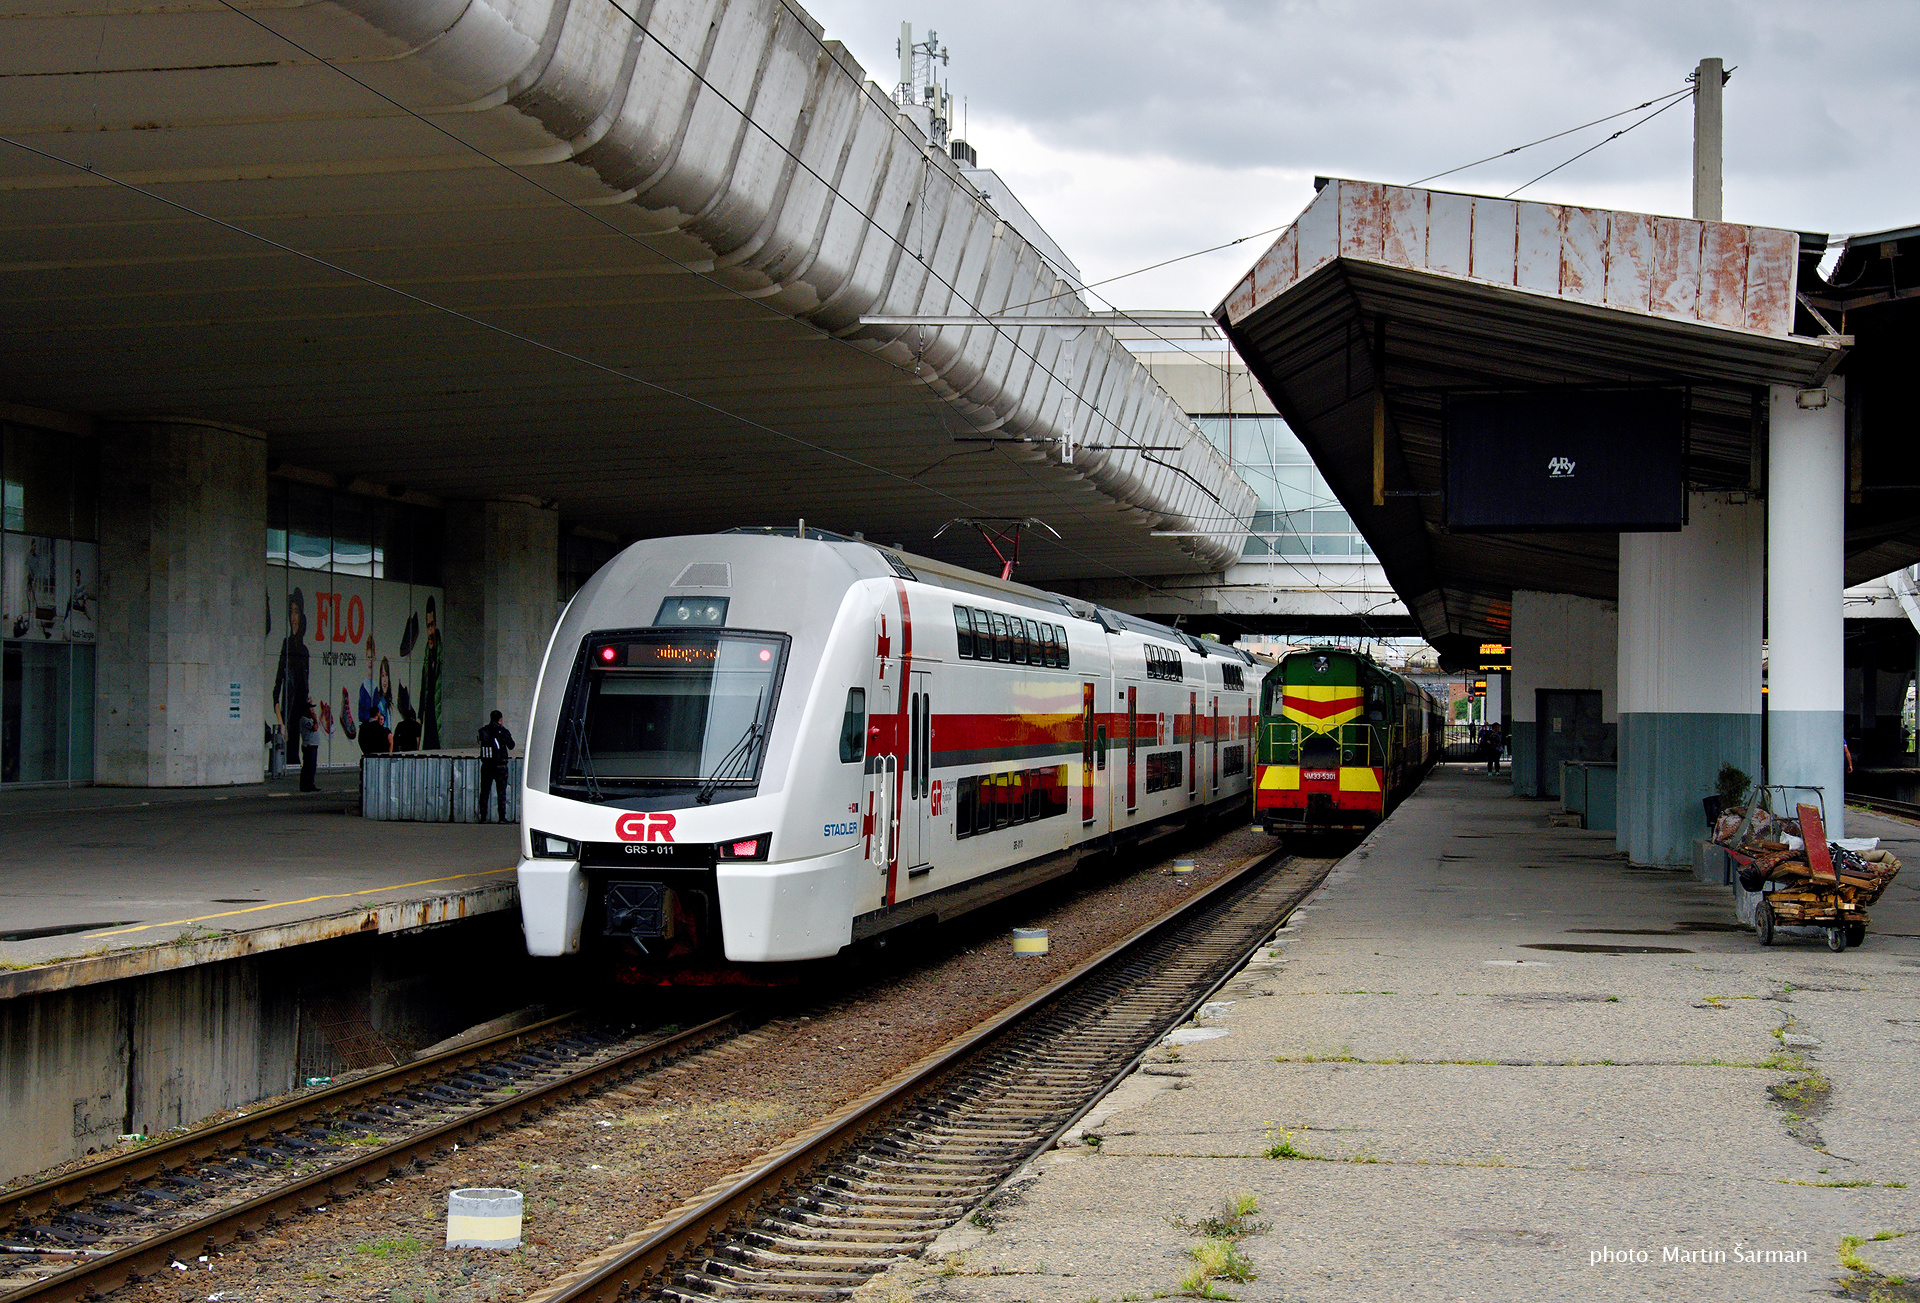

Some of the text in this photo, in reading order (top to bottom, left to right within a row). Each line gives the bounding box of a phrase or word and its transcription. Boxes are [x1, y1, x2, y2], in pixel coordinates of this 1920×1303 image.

[315, 591, 365, 644] FLO
[323, 651, 357, 667] NOW OPEN
[615, 812, 677, 842] GR
[823, 821, 858, 837] STADLER
[624, 845, 648, 854] GRS
[656, 845, 674, 855] 011
